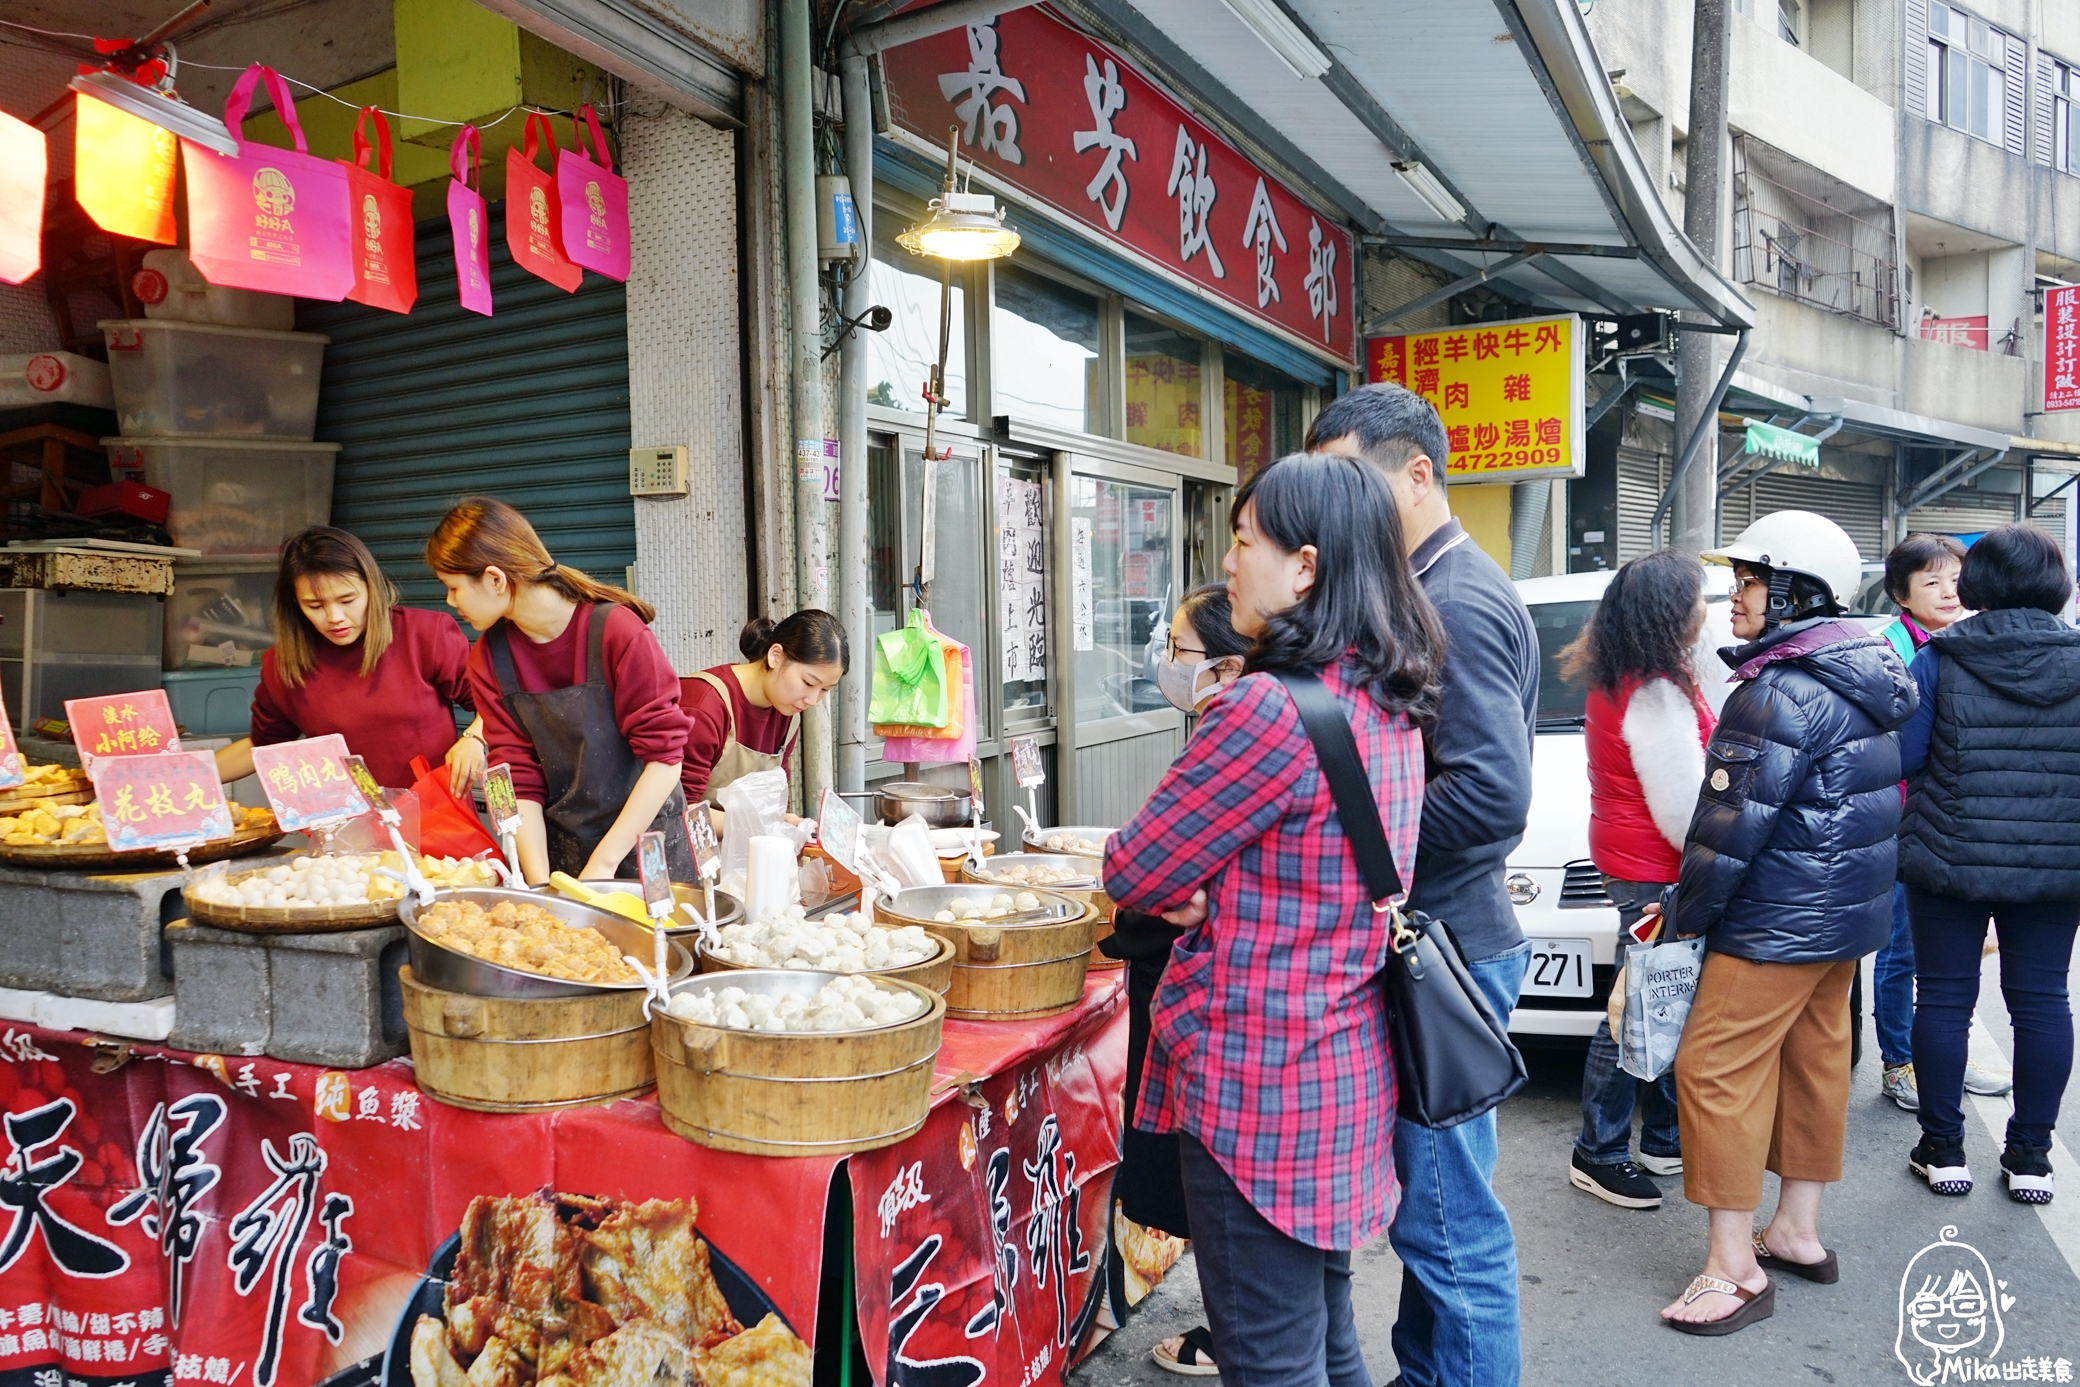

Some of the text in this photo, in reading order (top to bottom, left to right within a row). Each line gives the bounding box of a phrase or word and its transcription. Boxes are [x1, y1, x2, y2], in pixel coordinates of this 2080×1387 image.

[938, 14, 1338, 344] 嘉芳飲食部
[255, 213, 295, 235] 好好丸
[1412, 338, 1441, 417] 經濟
[1024, 488, 1045, 674] 歡迎光臨
[102, 703, 139, 725] 淡水
[95, 725, 163, 754] 小阿給
[267, 756, 348, 795] 鴨肉丸
[113, 781, 218, 824] 花枝丸
[1647, 966, 1694, 985] PORTER
[315, 1075, 422, 1131] 純魚漿
